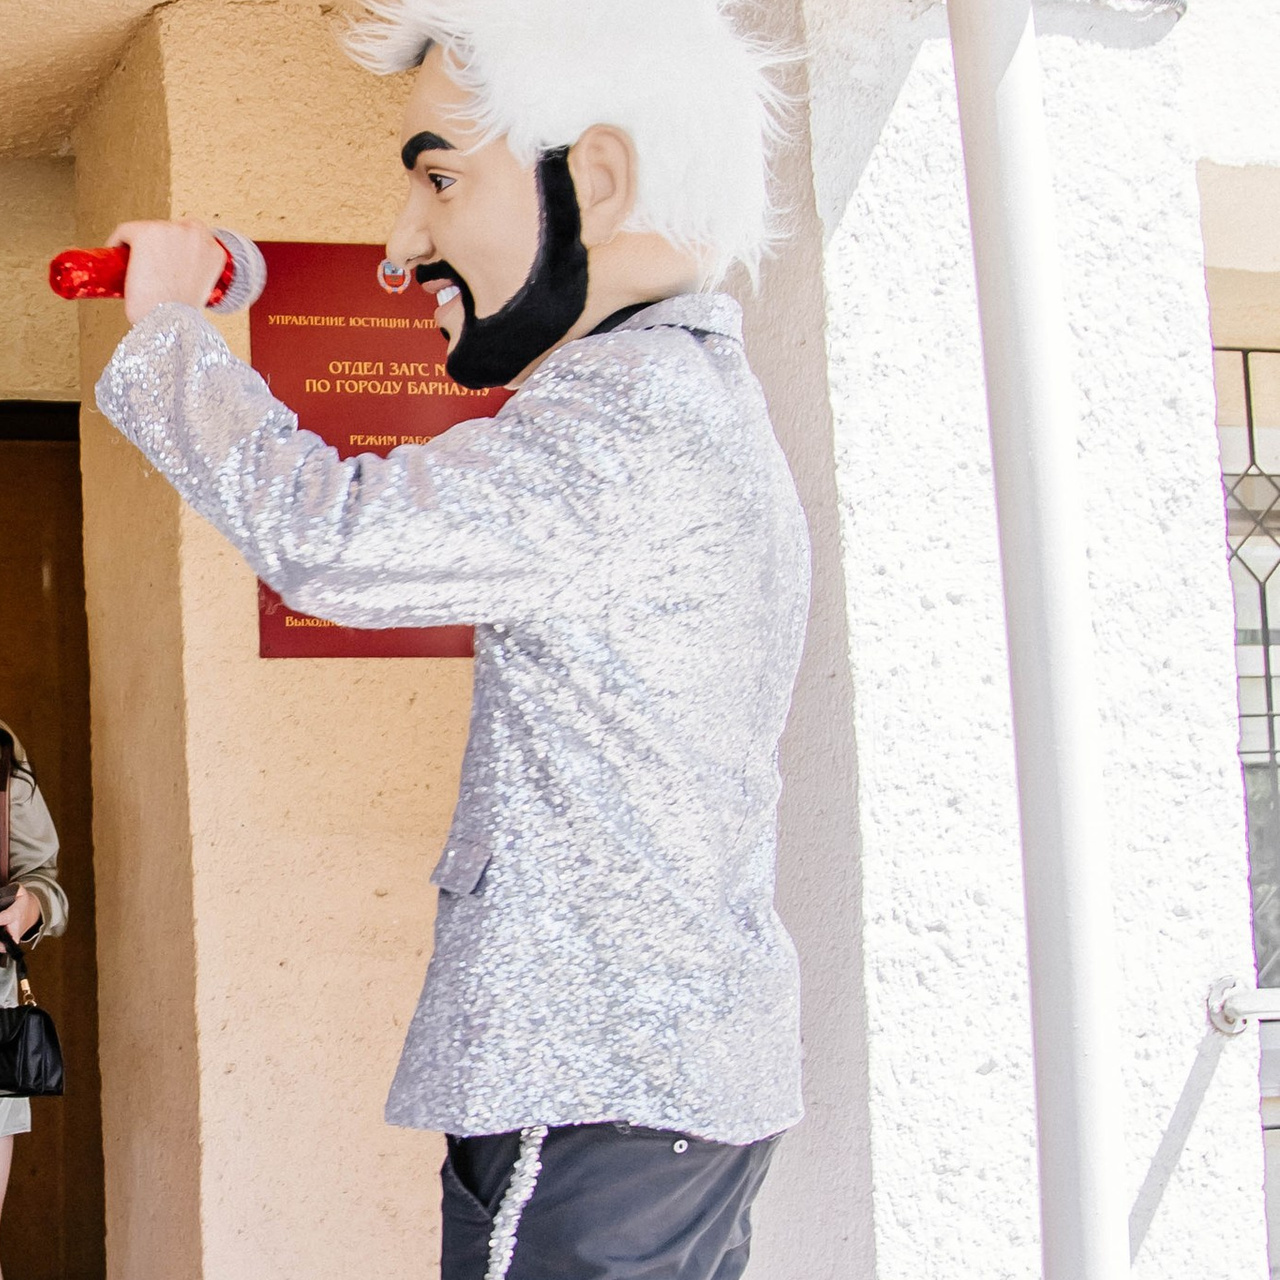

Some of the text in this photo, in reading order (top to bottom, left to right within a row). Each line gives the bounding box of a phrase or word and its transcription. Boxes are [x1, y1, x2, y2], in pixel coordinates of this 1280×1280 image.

[268, 315, 345, 327] УПРАВЛЕНИЕ
[349, 317, 410, 329] ЮСТИЦИИ
[329, 361, 384, 376] ОТДЕЛ
[389, 362, 430, 376] ЗАГС
[305, 379, 331, 393] ПО
[336, 379, 402, 395] ГОРОДУ
[349, 434, 397, 446] РЕЖИМ
